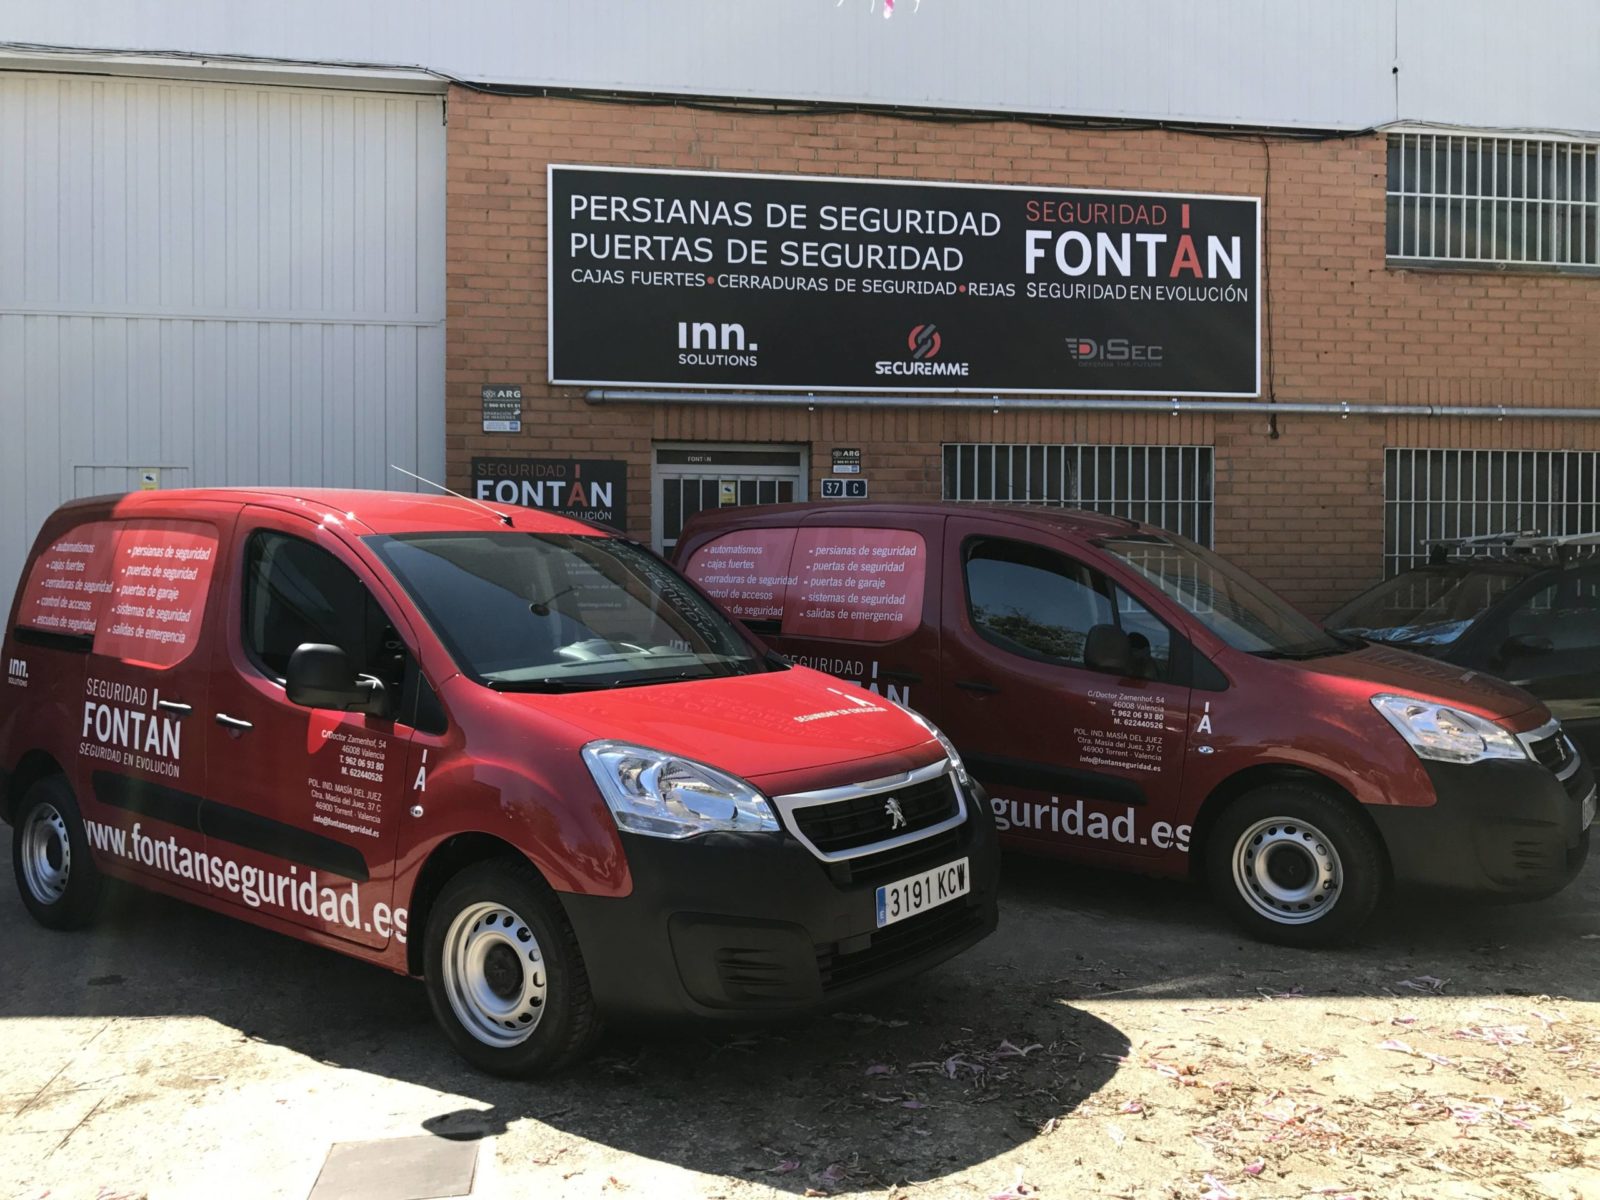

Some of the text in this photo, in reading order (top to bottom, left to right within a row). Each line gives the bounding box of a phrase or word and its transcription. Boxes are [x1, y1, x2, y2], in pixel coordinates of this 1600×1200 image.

[570, 194, 1001, 237] PERSIANAS DE SEGURIDAD
[1026, 200, 1167, 226] SEGURIDAD
[570, 232, 964, 272] PUERTAS DE SEGURIDAD
[570, 268, 1016, 298] CAJAS FUERTES CERRADURAS DE SEGURIDAD REJAS
[1026, 283, 1248, 303] SEGURIDAD EN EVOLUCIÓN
[678, 353, 758, 367] SOLUTIONS
[875, 361, 969, 376] SECUREMME
[497, 390, 521, 398] ARG
[477, 463, 567, 477] SEGURIDAD
[826, 482, 859, 495] 37 C
[165, 546, 174, 558] de
[175, 547, 211, 561] seguridad
[710, 545, 762, 554] automatismos
[815, 546, 917, 557] persianas de seguridad
[707, 559, 754, 570] cajas fuertes
[812, 561, 905, 573] puertas de seguridad
[126, 564, 198, 581] puertas de seguridad
[75, 579, 83, 590] de
[704, 574, 798, 586] cerraduras de seguridad
[810, 577, 886, 589] puertas de garaje
[147, 585, 156, 597] de
[730, 589, 740, 599] de
[741, 591, 773, 600] accesos
[808, 592, 906, 605] sistemas de seguridad
[146, 605, 155, 618] de
[156, 608, 191, 622] seguridad
[733, 604, 743, 614] de
[744, 606, 784, 616] seguridad
[806, 608, 903, 622] salidas de emergencia
[135, 625, 144, 638] de
[86, 677, 147, 706] SEGURIDAD
[1087, 690, 1117, 700] C/Doctor
[1113, 701, 1164, 712] 46008 Valencia
[1110, 709, 1164, 721] T. 962 06 93 80
[1124, 719, 1163, 729] 622440526
[1073, 727, 1163, 745] POL. IND. MASÍA DEL JUEZ
[378, 740, 387, 748] 54
[1077, 737, 1093, 745] Ctra.
[1115, 741, 1126, 749] del
[1146, 744, 1155, 752] 37
[1156, 745, 1162, 753] C
[341, 745, 385, 760] 46008 Valencia
[1082, 745, 1162, 761] 46900 Torrent Valencia
[79, 742, 180, 778] SEGURIDAD EN EVOLUCIÓN
[345, 756, 357, 766] 962
[358, 758, 366, 767] 06
[367, 760, 375, 769] 93
[376, 762, 384, 771] 80
[1079, 755, 1161, 772] info@fontanseguridad.es
[308, 778, 321, 788] POL.
[354, 789, 365, 799] DEL
[366, 791, 381, 802] JUEZ
[342, 796, 350, 807] del
[367, 801, 376, 811] 37
[376, 803, 381, 813] C
[334, 805, 353, 818] Torrent
[357, 811, 381, 824] Valencia
[890, 876, 931, 917] 3191
[937, 863, 965, 900] KCW
